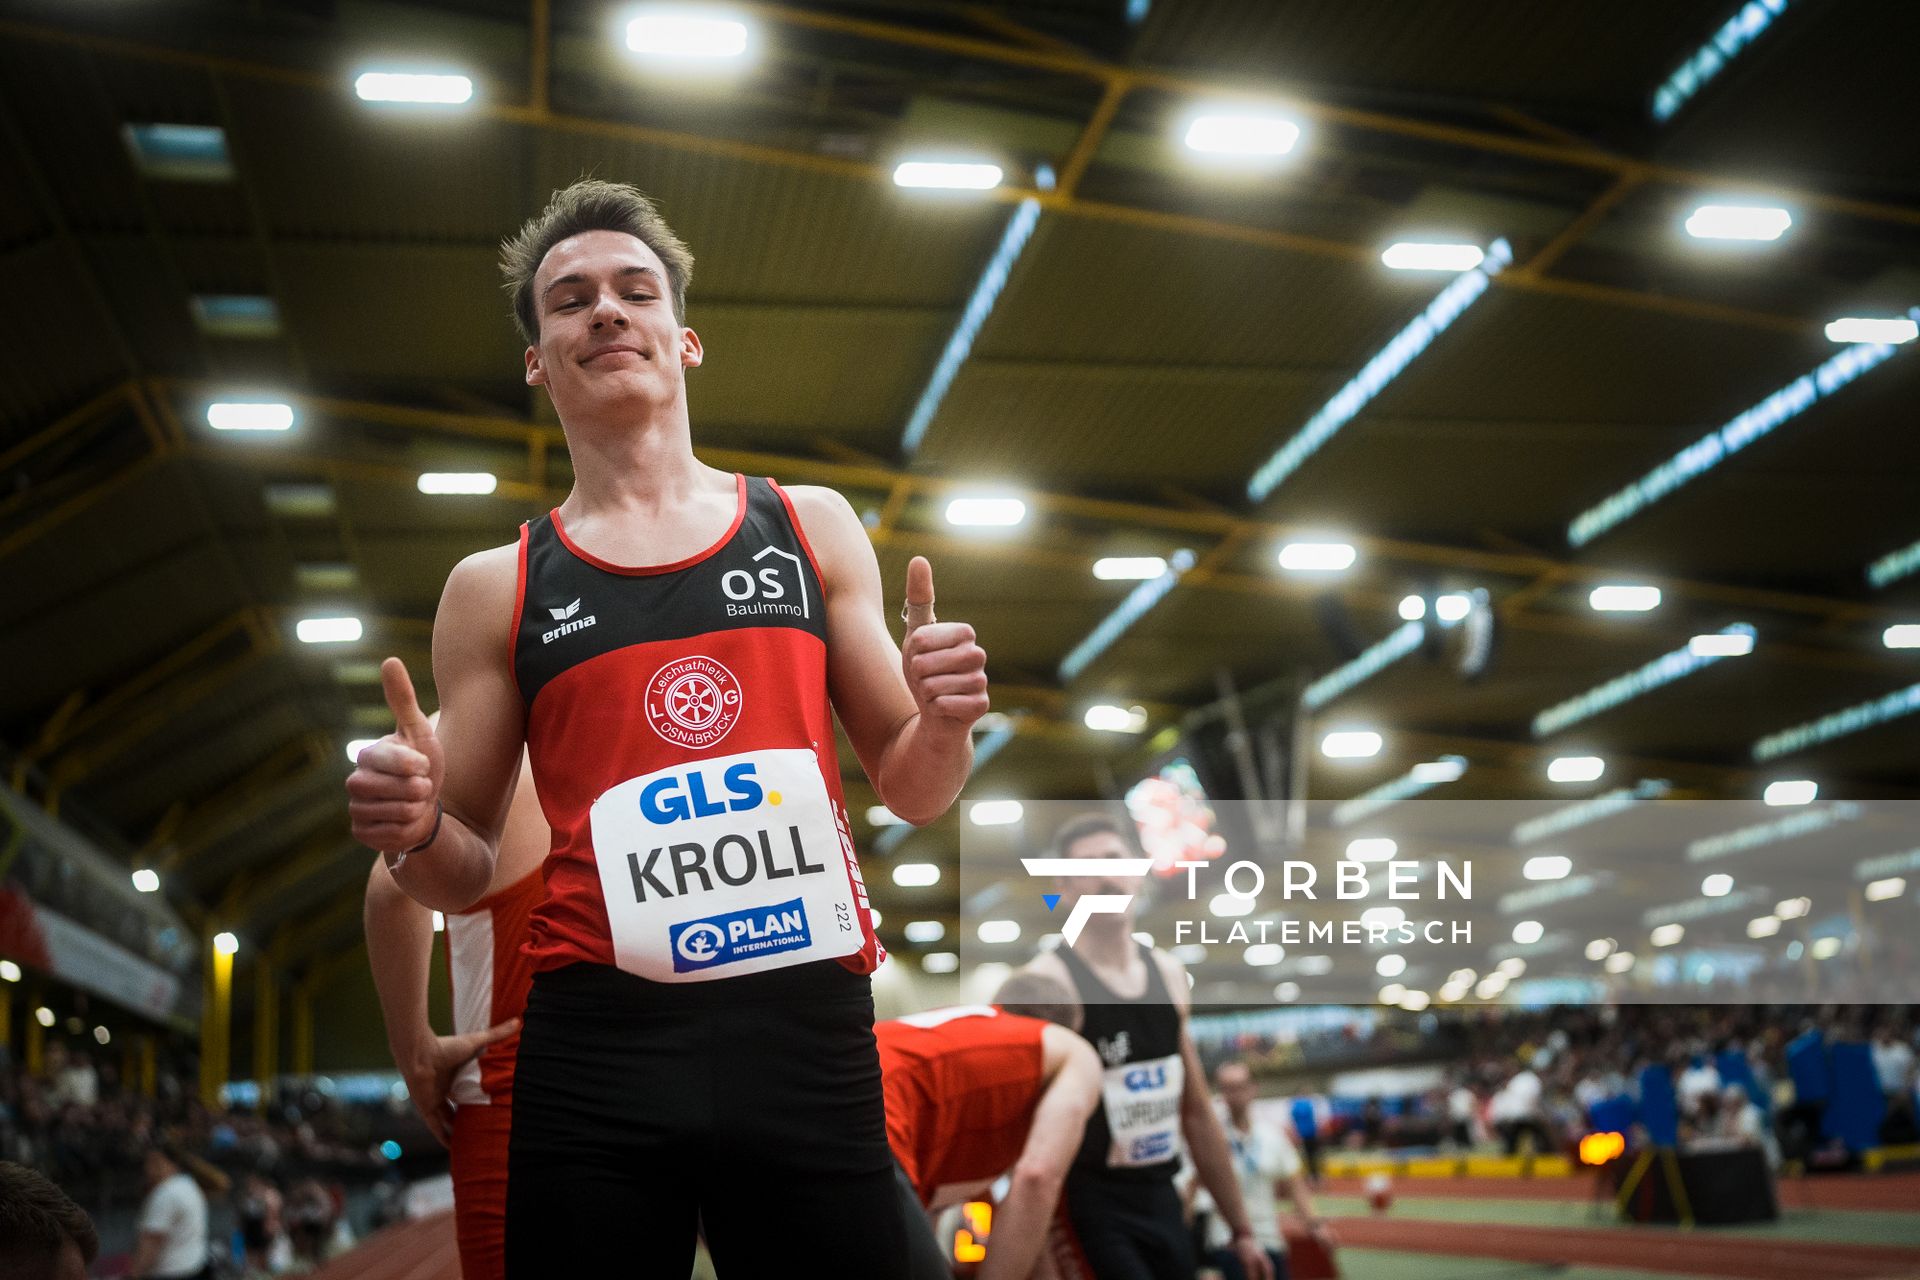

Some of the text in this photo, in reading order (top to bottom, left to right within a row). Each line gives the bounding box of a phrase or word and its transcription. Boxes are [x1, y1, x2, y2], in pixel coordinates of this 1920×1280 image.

[721, 568, 785, 601] OS
[726, 601, 802, 617] BauImmo
[542, 614, 597, 645] erima
[652, 660, 728, 695] Leichtathletik
[660, 711, 734, 744] OSNABRÜCK
[626, 825, 825, 904] KROLL
[728, 908, 803, 943] PLAN
[834, 902, 852, 933] 222
[733, 934, 806, 955] INTERNATIONAL
